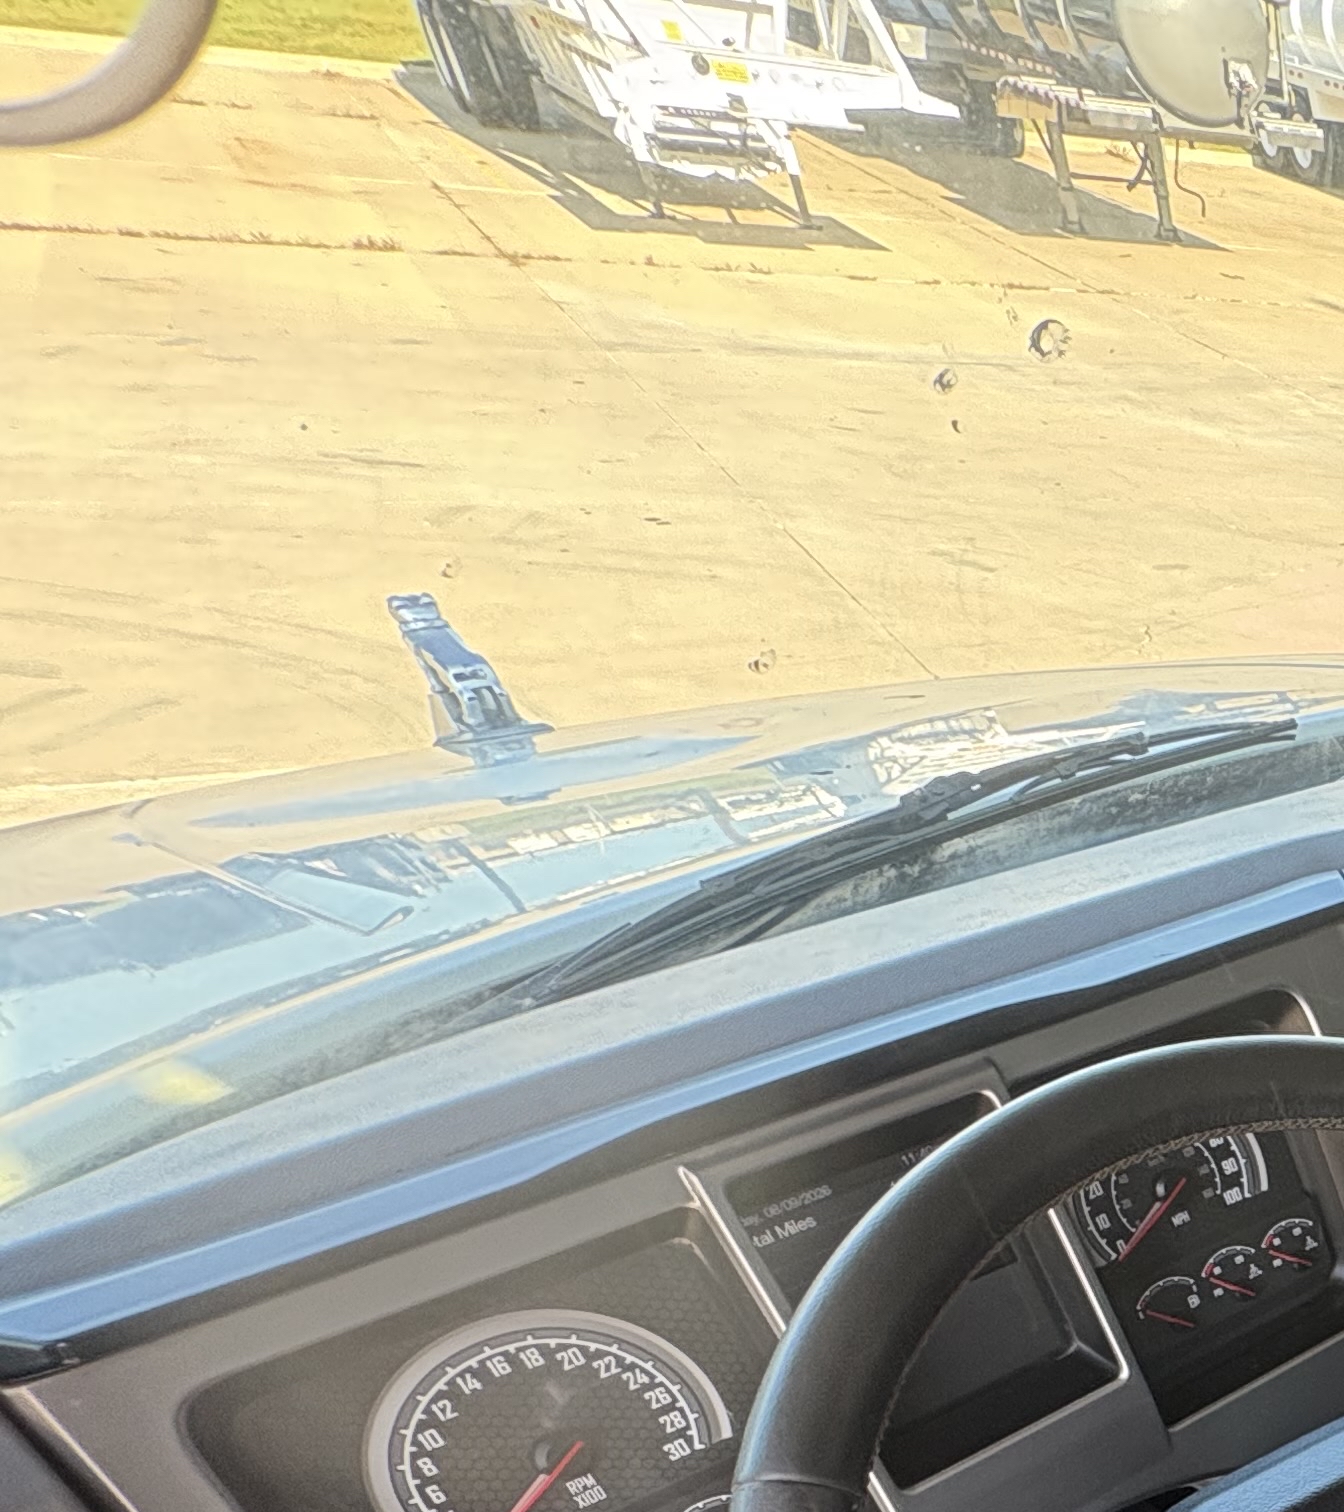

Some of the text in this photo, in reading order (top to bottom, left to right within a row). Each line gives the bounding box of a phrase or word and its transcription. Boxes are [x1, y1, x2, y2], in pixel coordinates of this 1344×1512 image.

[1221, 1157, 1239, 1175] 90
[1086, 1181, 1104, 1200] 20
[1223, 1187, 1243, 1205] 100
[753, 1216, 817, 1249] tal Miles
[1095, 1213, 1111, 1231] 10
[486, 1356, 512, 1377] 16
[519, 1348, 545, 1369] 18
[556, 1347, 587, 1371] 20
[592, 1355, 622, 1379] 22
[455, 1373, 482, 1395] 14
[621, 1368, 650, 1391] 24
[644, 1386, 673, 1410] 26
[431, 1400, 459, 1423] 12
[658, 1411, 687, 1434] 28
[417, 1429, 446, 1451] 10
[663, 1439, 692, 1462] 30
[416, 1456, 439, 1477] 8
[425, 1484, 447, 1505] 6
[565, 1473, 597, 1496] RPM
